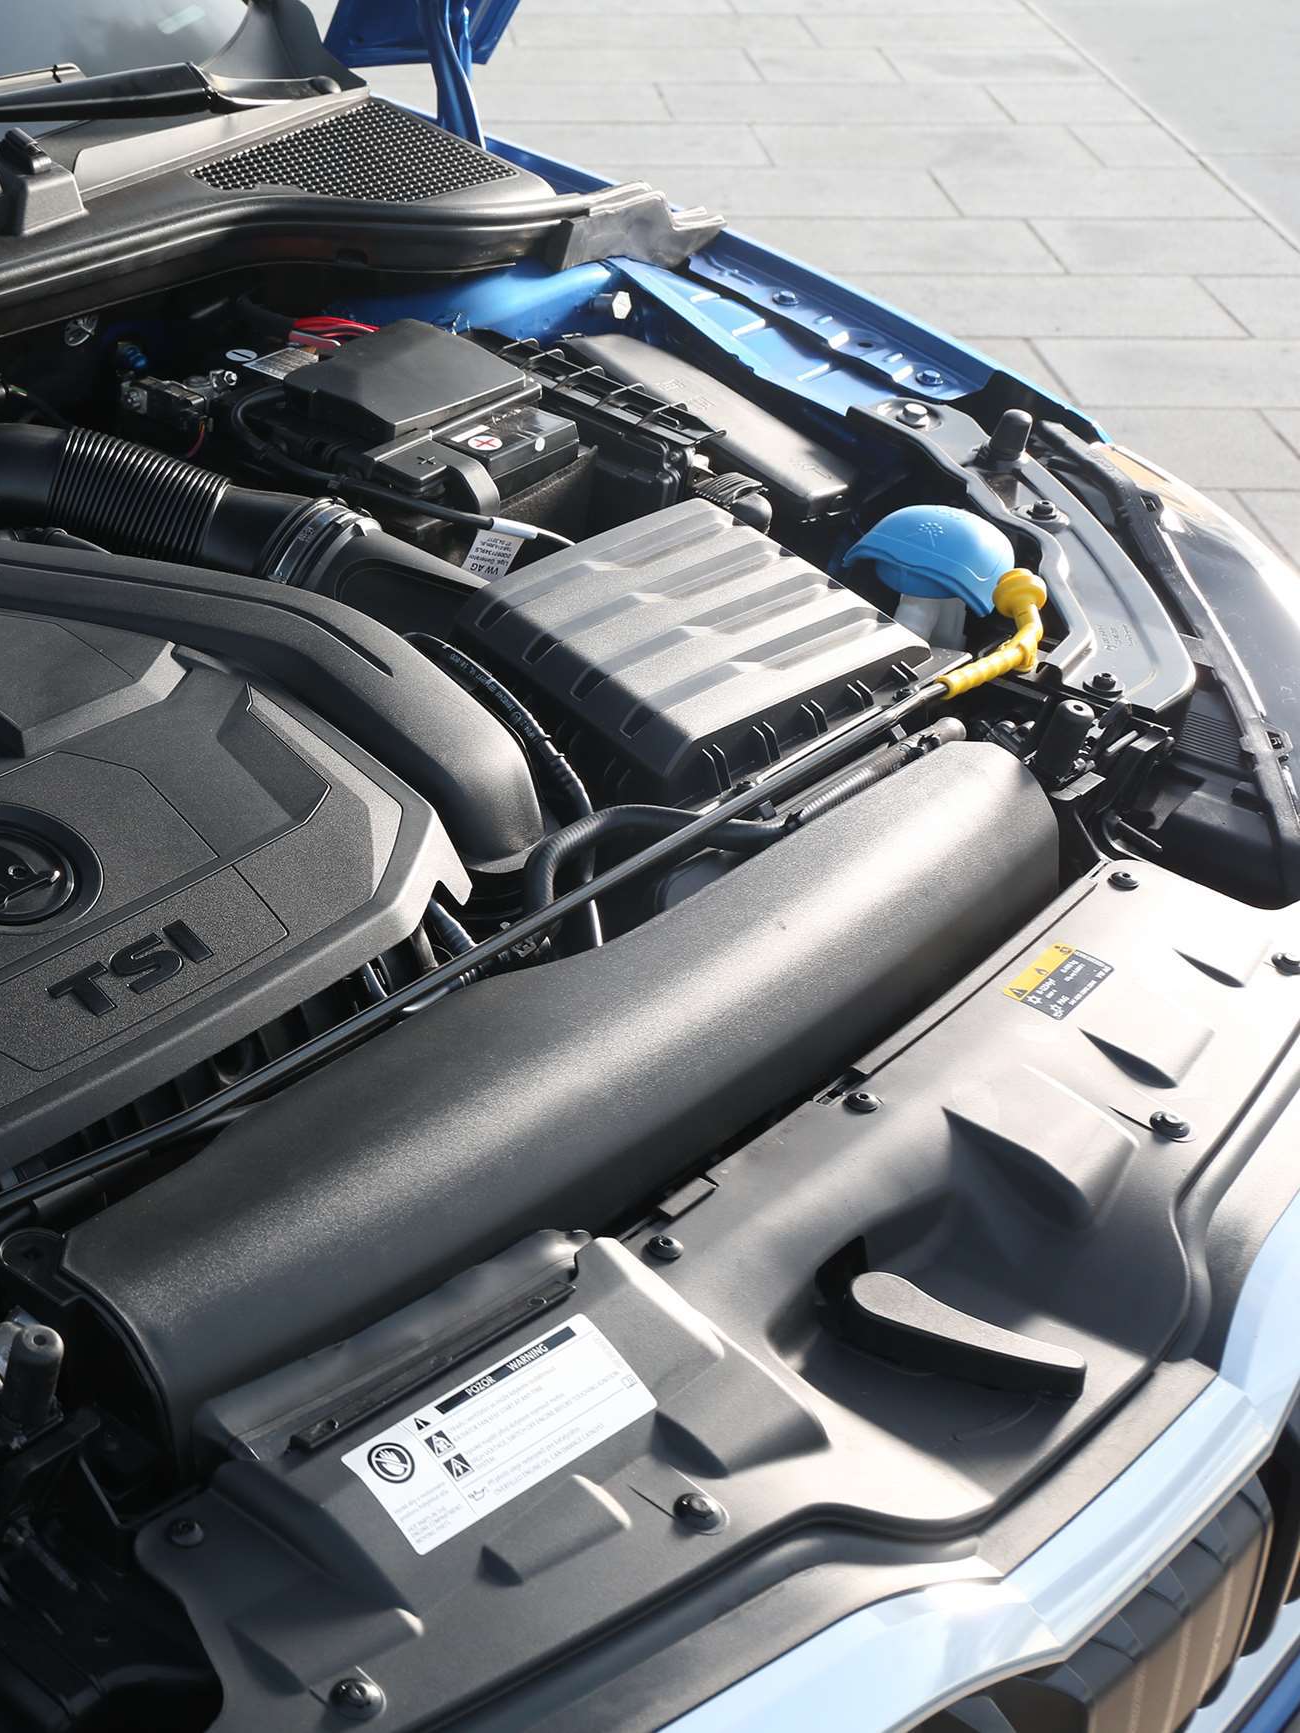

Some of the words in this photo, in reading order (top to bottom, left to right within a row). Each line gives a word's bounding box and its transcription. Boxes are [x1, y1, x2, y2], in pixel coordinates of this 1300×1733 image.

[470, 563, 485, 572] AG
[485, 566, 499, 575] VW
[45, 919, 215, 1017] TSI
[465, 1374, 497, 1398] POZOR
[506, 1343, 549, 1373] WARNING
